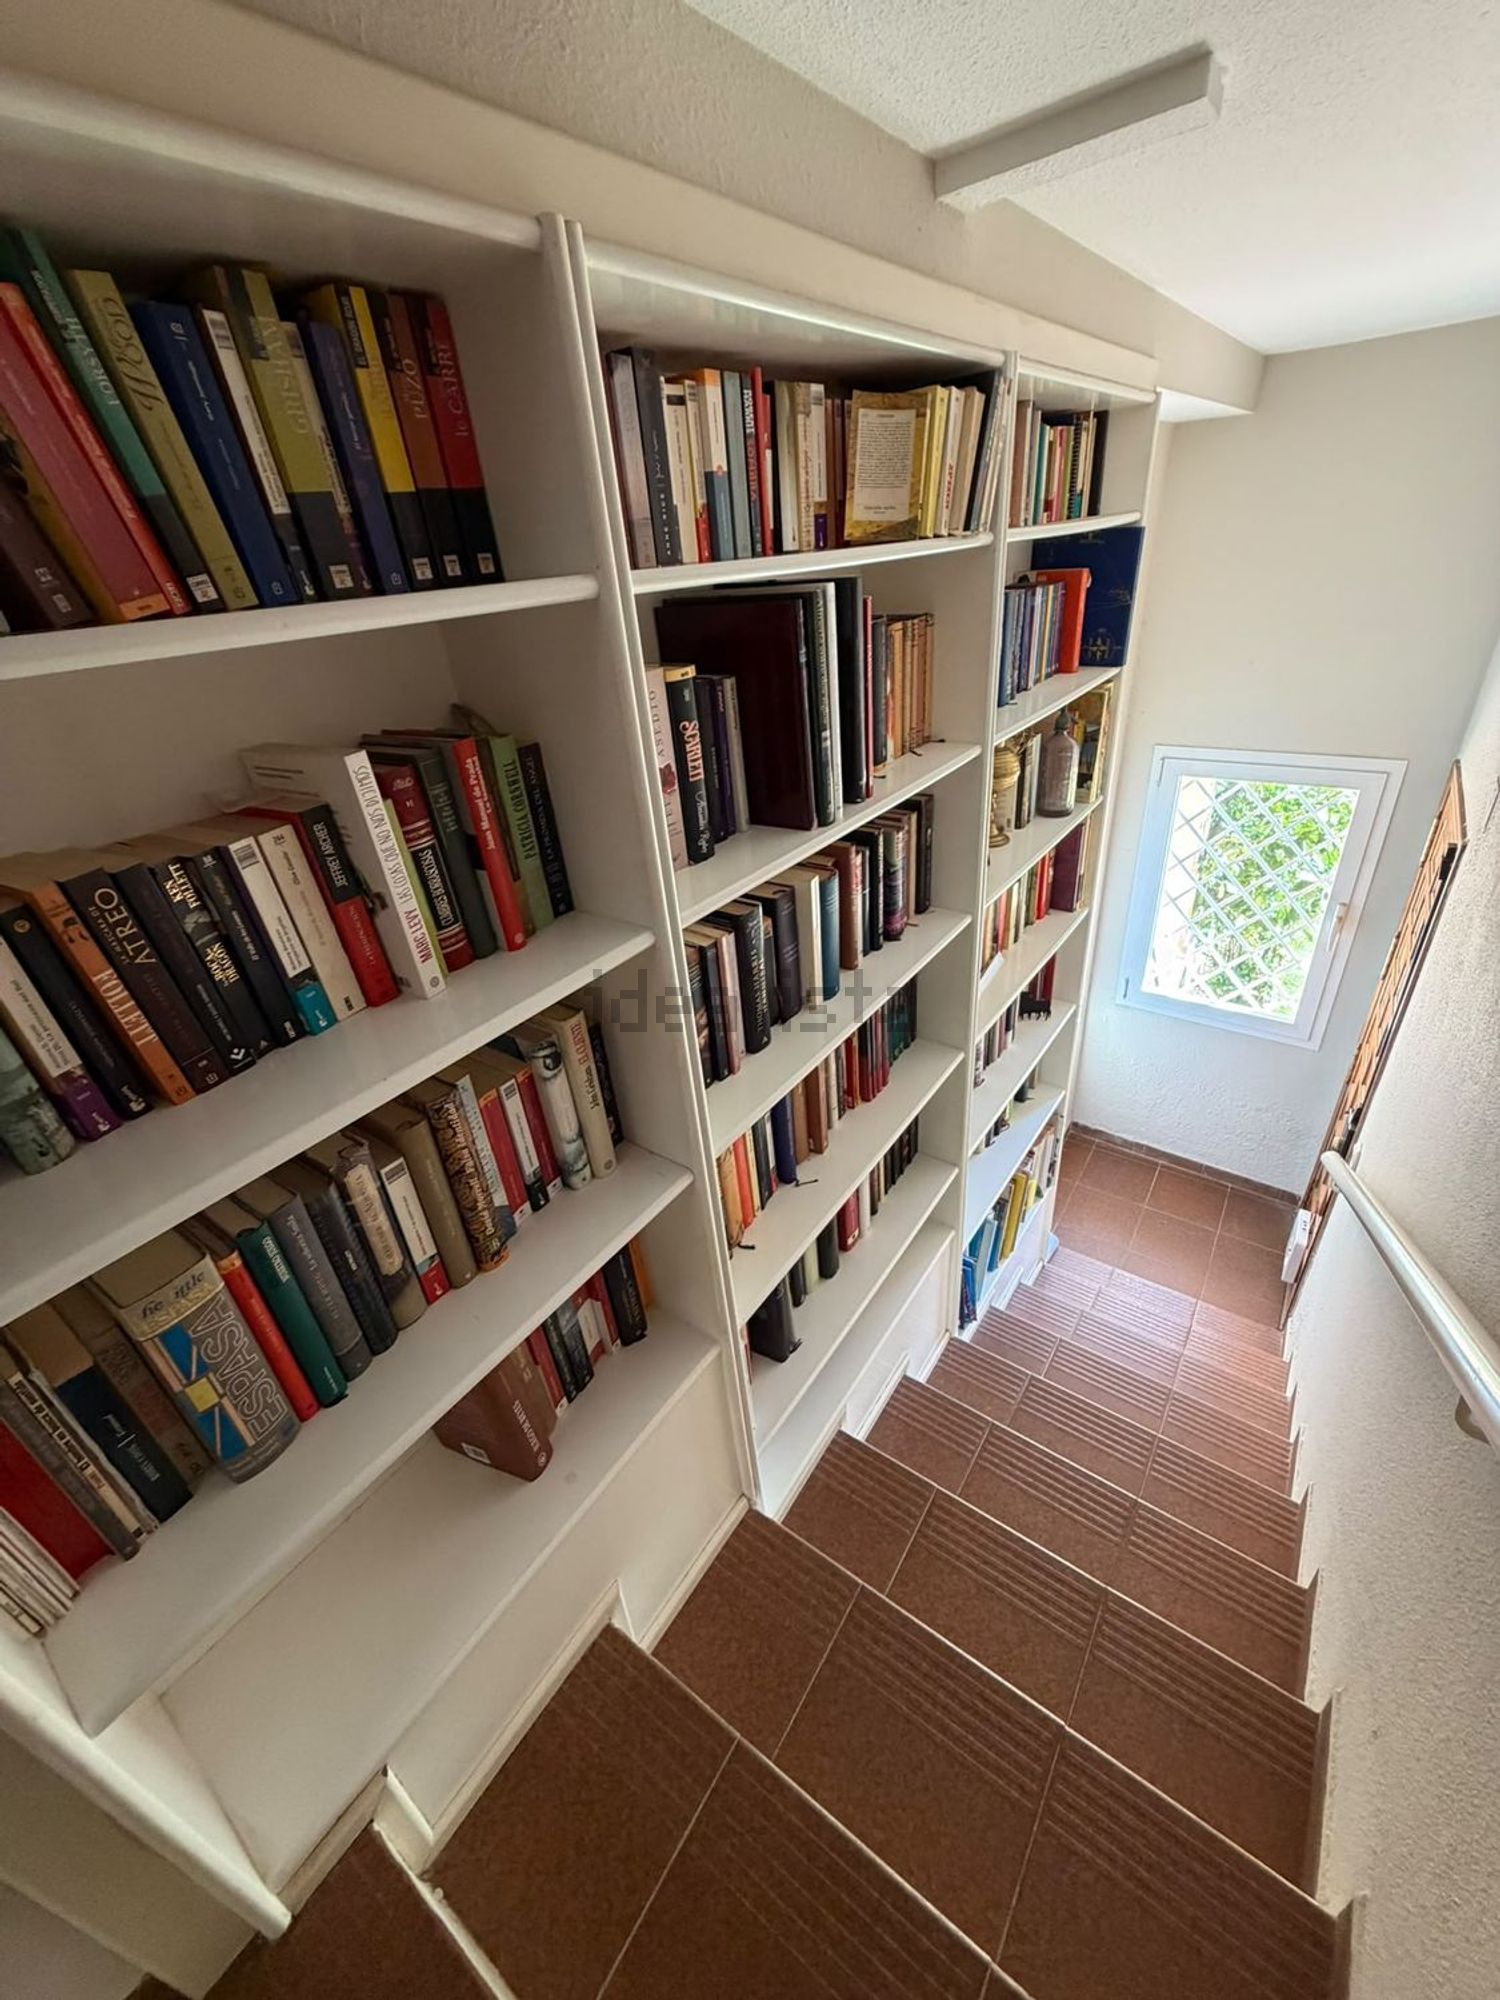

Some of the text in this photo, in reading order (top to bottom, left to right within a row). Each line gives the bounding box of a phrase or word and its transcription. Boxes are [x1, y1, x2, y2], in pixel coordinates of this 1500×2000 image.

[65, 317, 120, 405] FORSYTH
[259, 316, 309, 435] GRISHAM
[402, 358, 428, 419] PUZO
[465, 756, 479, 786] Prada
[678, 720, 705, 783] SCARLETT
[473, 785, 483, 798] de
[479, 797, 495, 831] Manuel
[502, 759, 539, 861] PATRICIA CORNWELL
[313, 821, 349, 888] JEFFREY ARCHER
[486, 830, 498, 851] Juan
[168, 862, 201, 909] FOLLETT
[352, 764, 433, 964] MARC LEVY LAS COSAS QUE NO NOS DIJIMOS
[418, 848, 448, 897] BORRASCOSAS
[163, 879, 185, 903] KEN
[433, 893, 455, 927] CUMBRES
[94, 888, 158, 964] ATREO
[206, 951, 223, 983] BOCA
[749, 948, 763, 1031] THOMAS HARRIS
[92, 969, 161, 1047] FOLLETT
[578, 1054, 589, 1066] EL
[443, 1102, 467, 1147] Identidad
[461, 1147, 477, 1176] Falsa
[477, 1209, 497, 1237] David
[190, 1294, 288, 1441] ESPASA
[34, 1403, 47, 1415] de
[41, 1411, 60, 1434] busca
[55, 1429, 66, 1441] en
